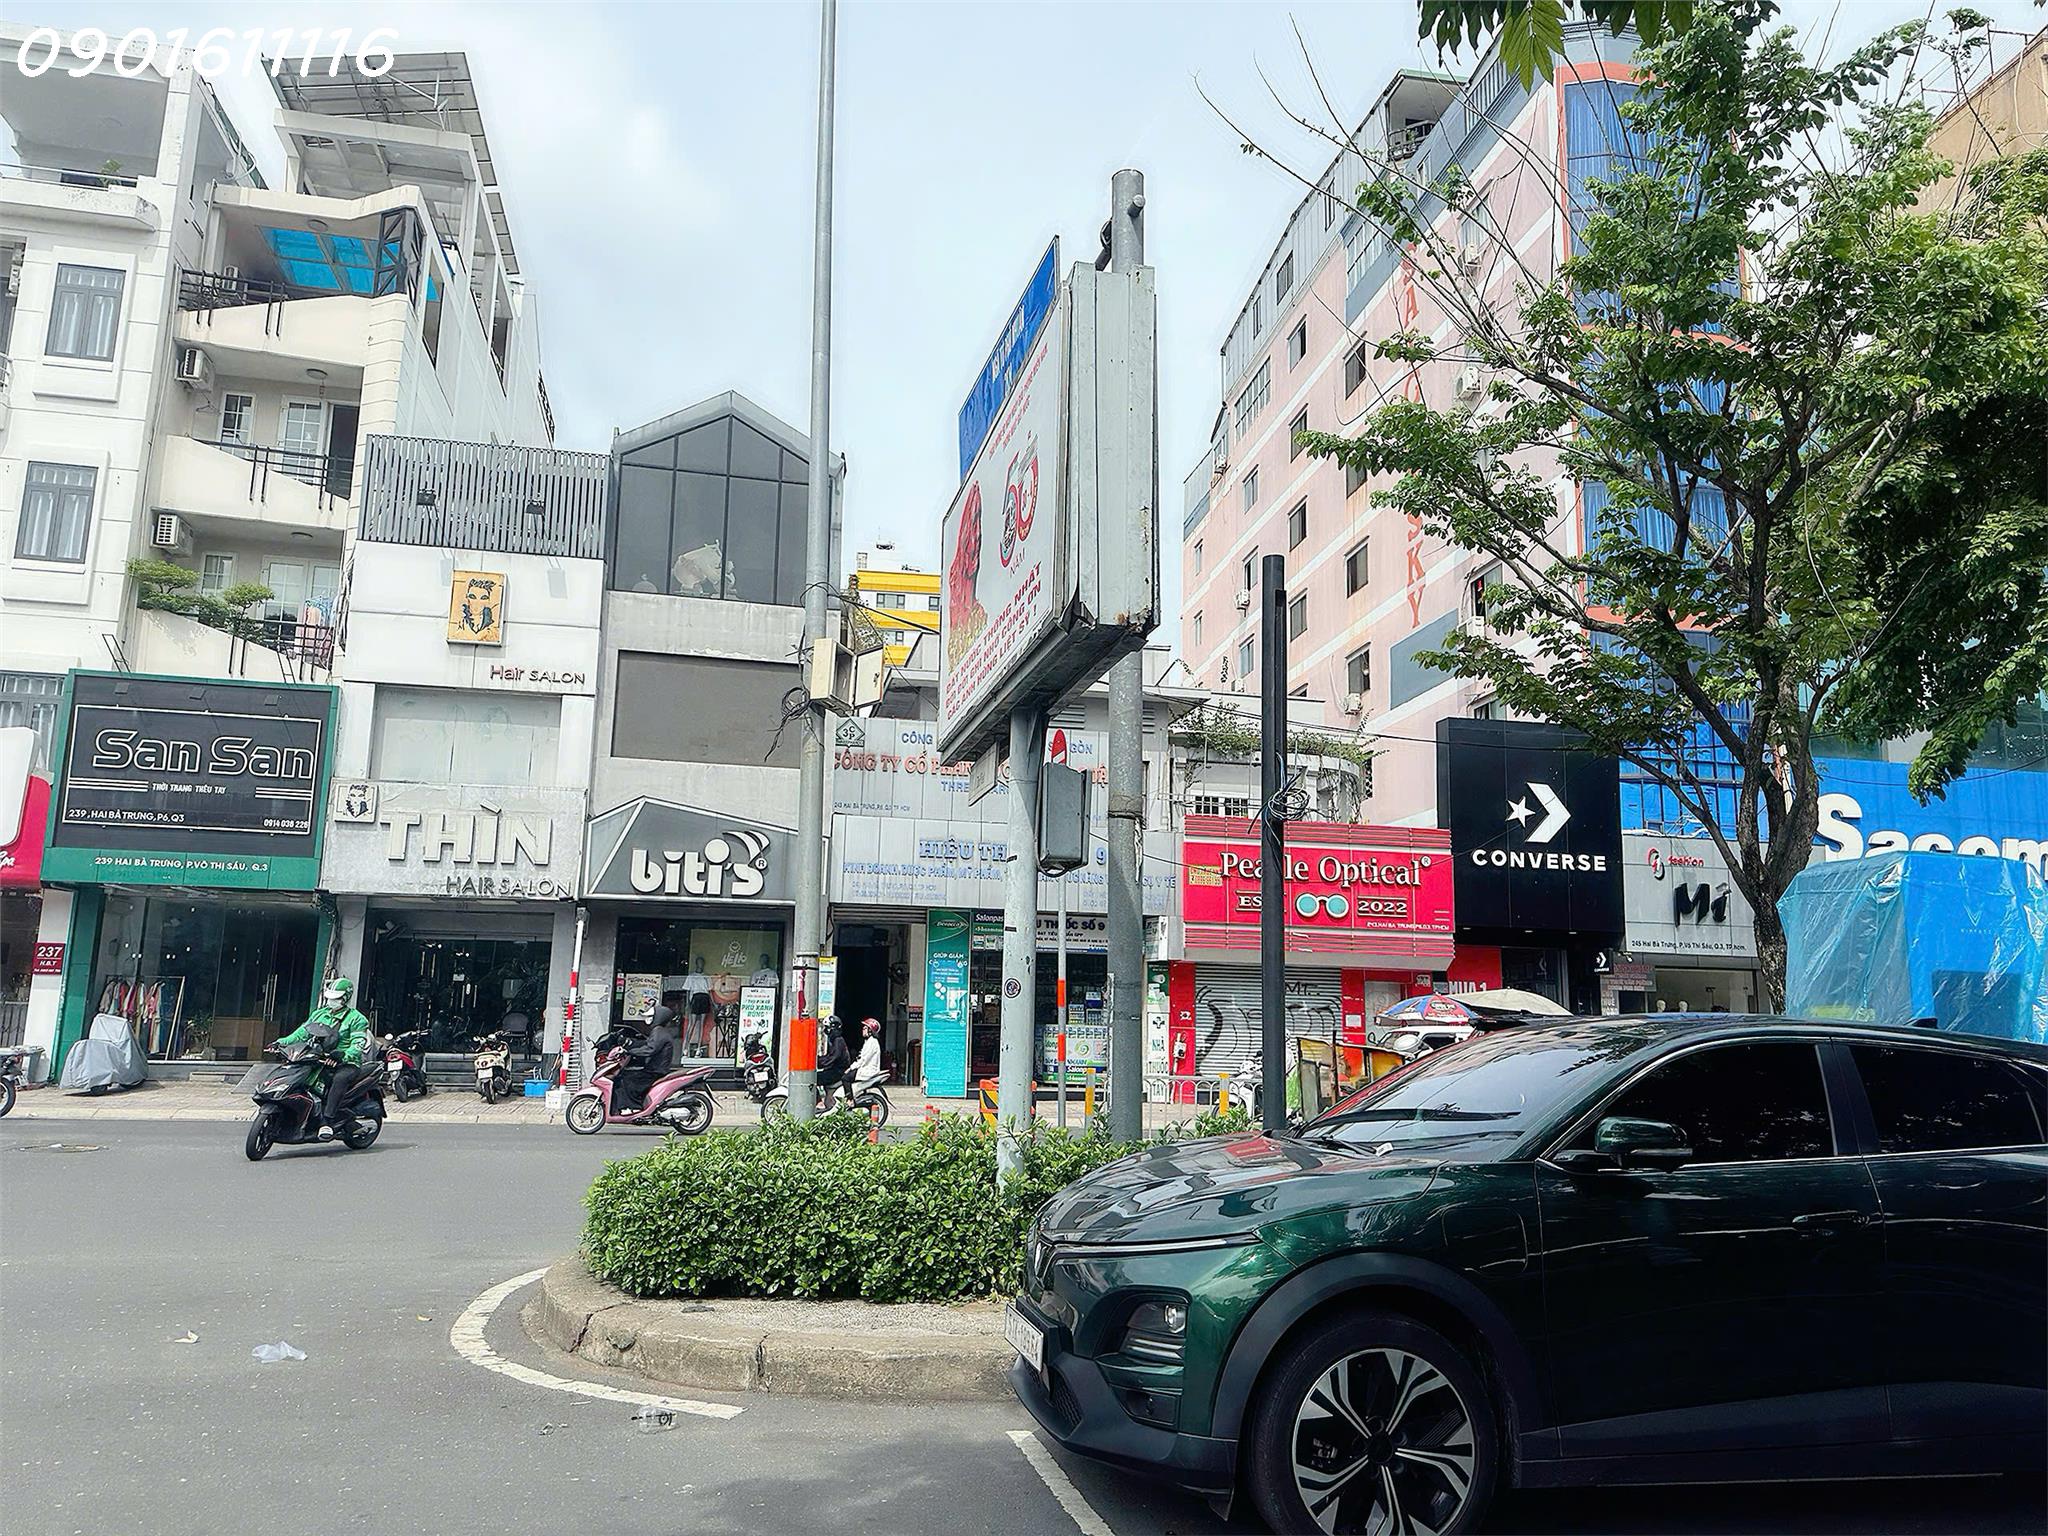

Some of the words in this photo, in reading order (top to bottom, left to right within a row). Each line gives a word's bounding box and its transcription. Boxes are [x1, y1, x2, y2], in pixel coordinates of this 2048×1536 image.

[489, 664, 525, 681] Hair
[529, 668, 586, 686] SALON
[902, 730, 933, 745] CÔNG
[92, 728, 201, 774] San
[208, 735, 317, 780] San
[1070, 740, 1093, 754] GÒN
[881, 755, 900, 773] TY
[170, 784, 192, 793] TRANG
[214, 786, 226, 795] TAY
[91, 810, 109, 819] HAI
[380, 799, 551, 865] THÌN
[95, 857, 113, 865] 239
[115, 857, 132, 866] HAI
[134, 857, 147, 867] BÀ
[251, 863, 268, 872] Q.3
[1096, 847, 1107, 865] 9
[1472, 849, 1607, 872] CONVERSE
[1220, 852, 1309, 882] Peale
[446, 876, 495, 893] HAIR
[499, 878, 573, 897] SALON
[1358, 900, 1407, 913] 2022
[37, 946, 62, 957] 237
